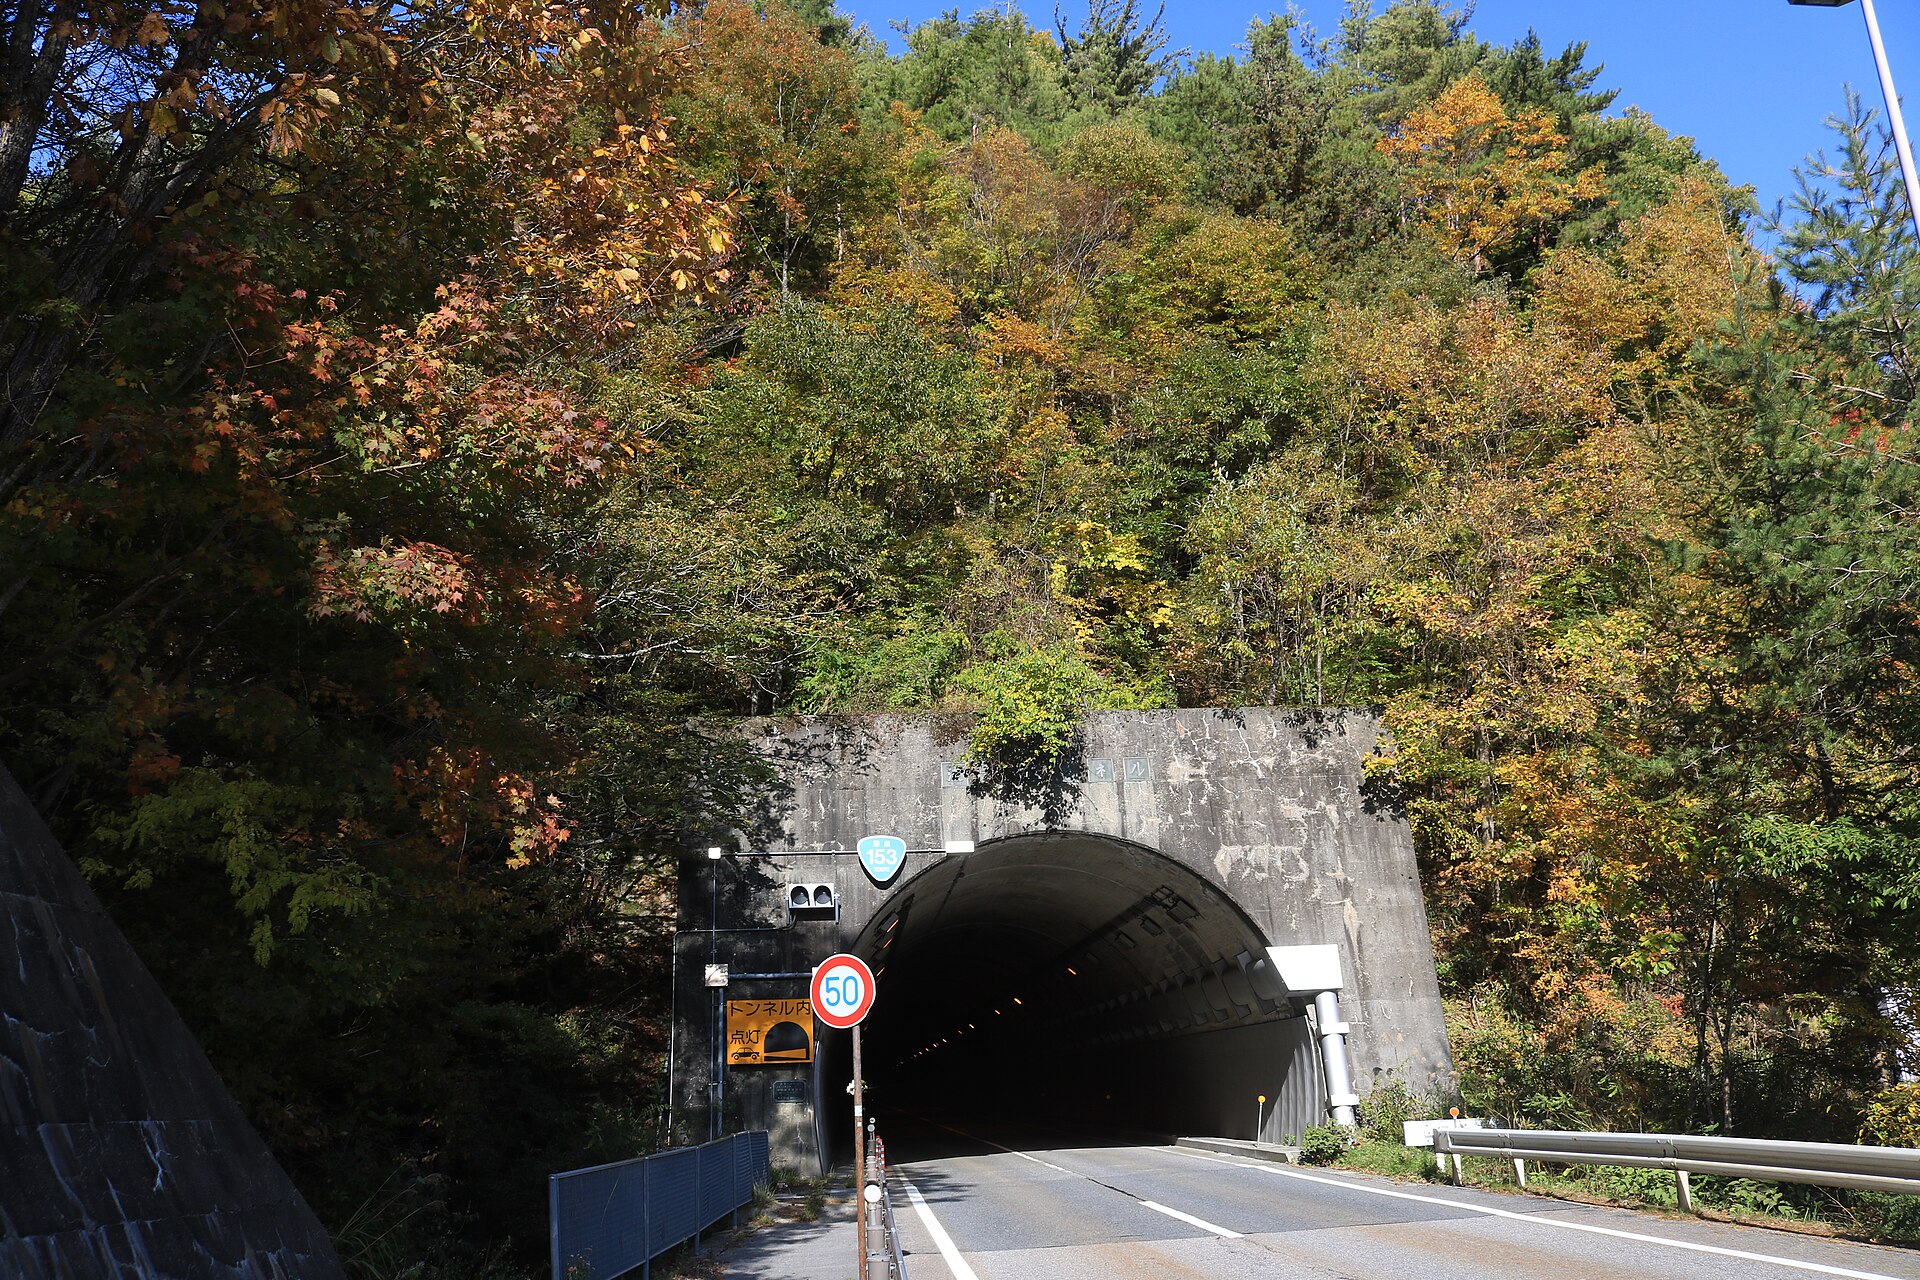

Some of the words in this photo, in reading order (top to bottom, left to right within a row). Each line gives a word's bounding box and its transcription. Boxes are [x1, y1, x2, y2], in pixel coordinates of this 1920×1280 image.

[866, 848, 897, 865] 153
[825, 975, 859, 1006] 50
[730, 1000, 811, 1016] トンネル内
[730, 1029, 761, 1045] 点灯
